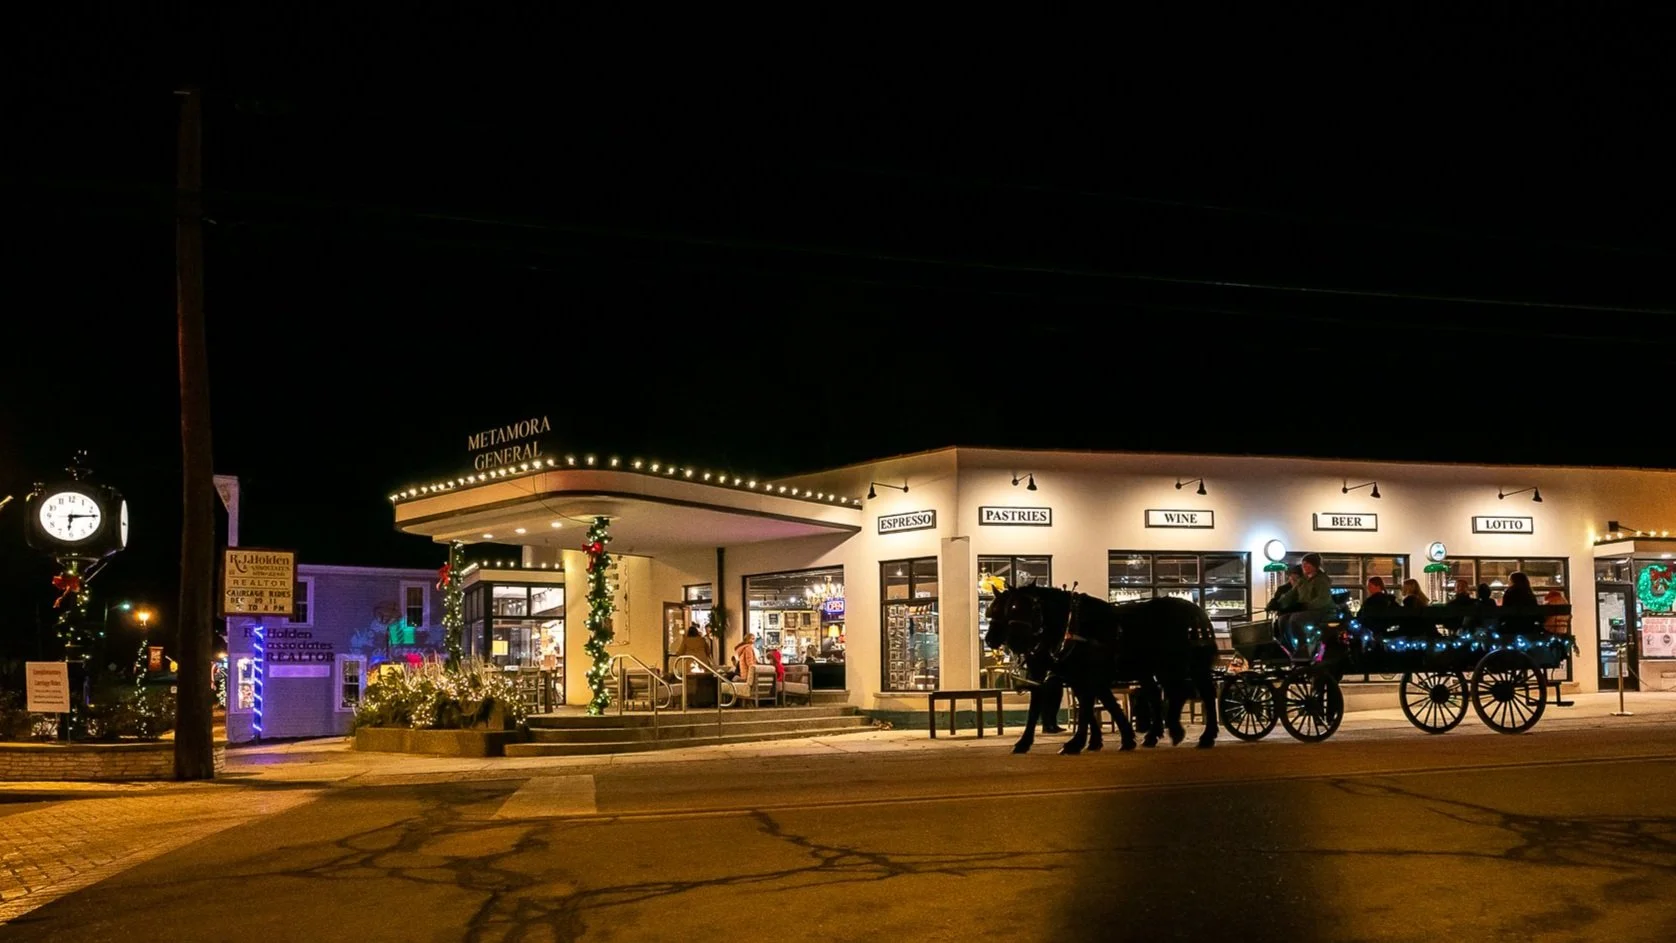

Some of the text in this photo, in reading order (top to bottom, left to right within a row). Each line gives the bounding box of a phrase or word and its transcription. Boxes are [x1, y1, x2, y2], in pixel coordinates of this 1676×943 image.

[468, 415, 551, 451] METAMORA
[474, 441, 543, 471] GENERAL
[985, 509, 1048, 522] PASTRIES
[1164, 513, 1198, 524] WINE
[880, 513, 932, 530] ESPRESSO
[1331, 516, 1363, 527] BEER
[1485, 519, 1524, 530] LOTTO
[233, 579, 287, 587] REALTOR
[267, 628, 313, 639] Holden
[266, 651, 336, 662] REALTOR
